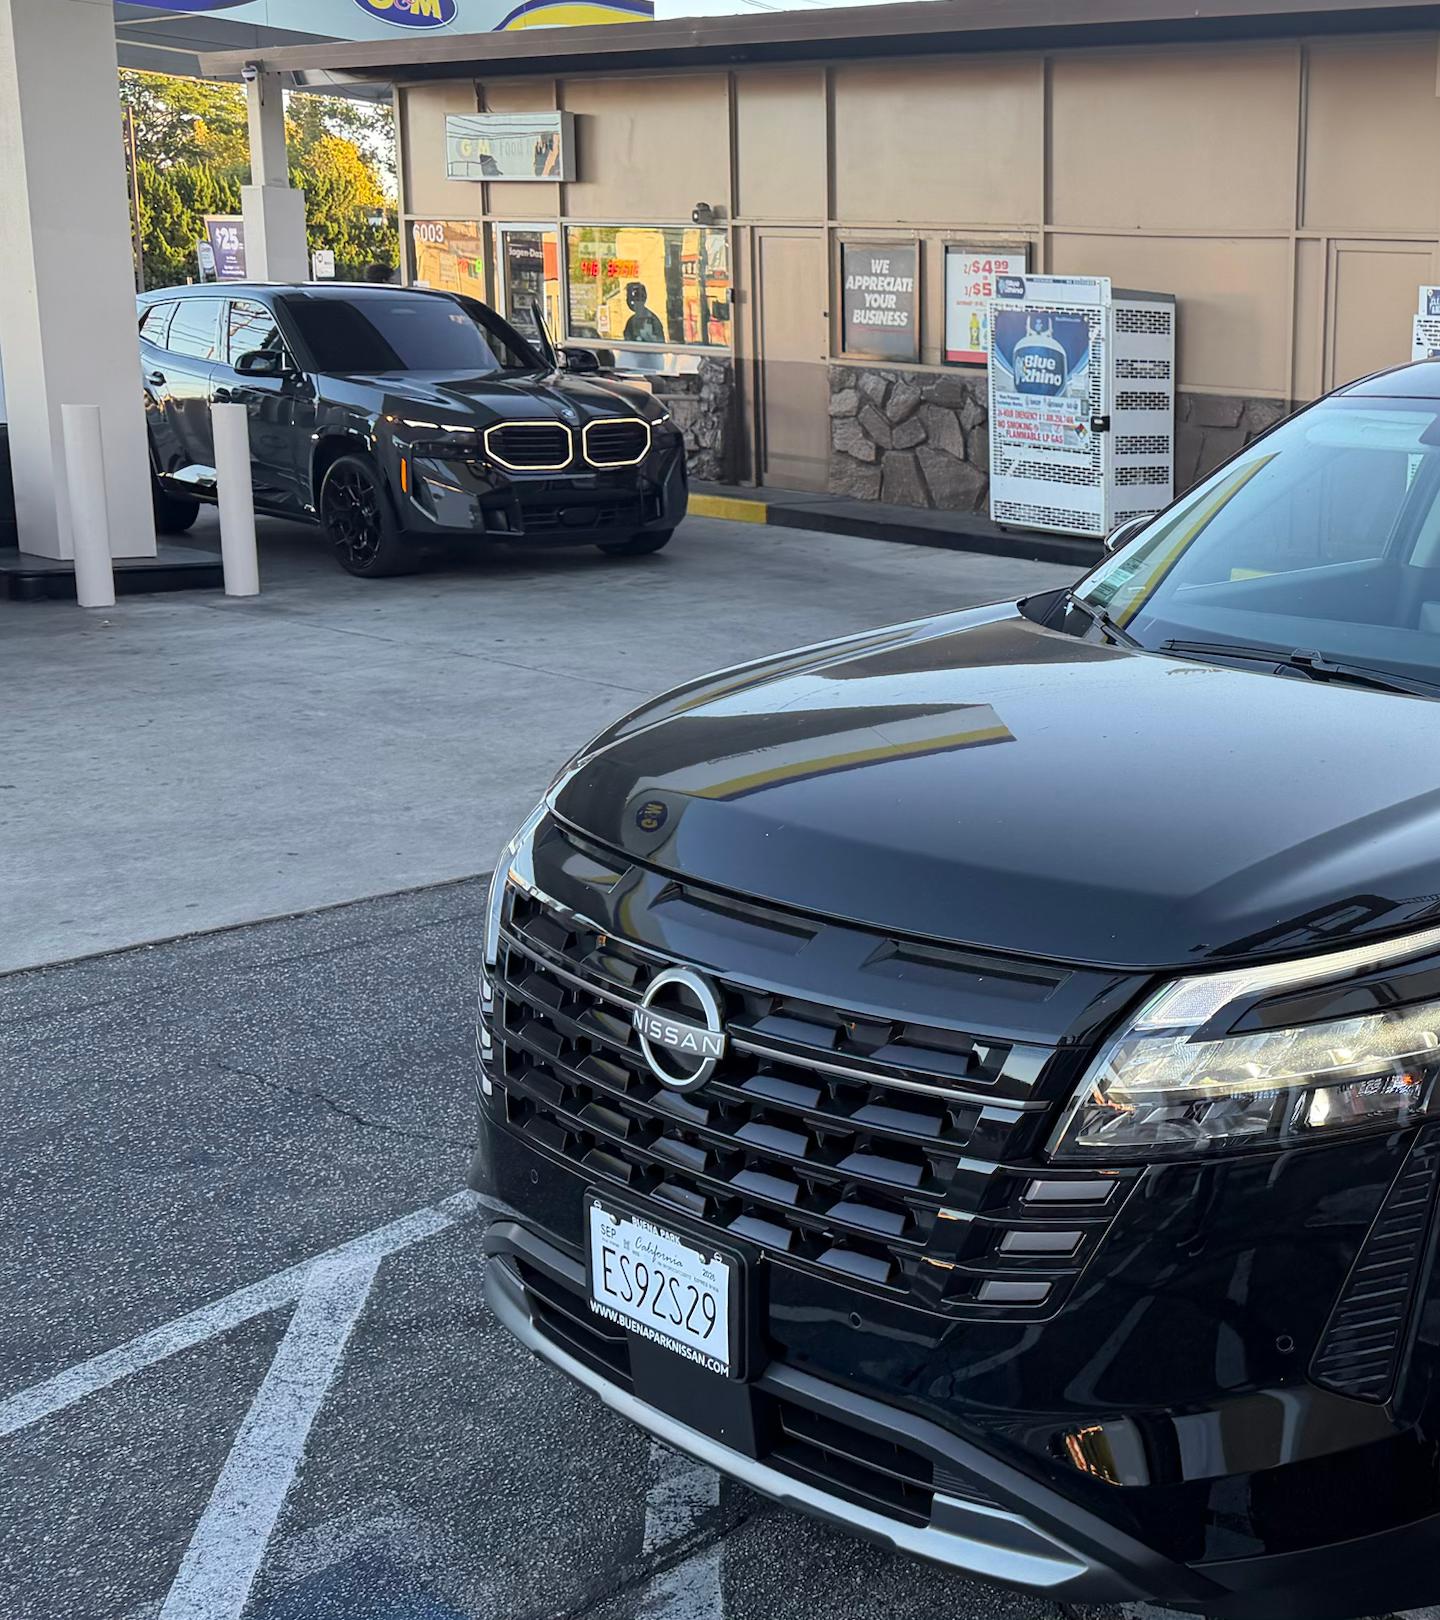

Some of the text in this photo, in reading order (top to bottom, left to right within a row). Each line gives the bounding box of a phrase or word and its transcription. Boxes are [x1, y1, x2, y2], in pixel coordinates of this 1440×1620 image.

[215, 227, 239, 250] $25
[413, 223, 444, 242] 6003
[871, 259, 890, 274] WE
[845, 275, 913, 292] APPRECIATE
[864, 293, 897, 309] YOUR
[852, 309, 908, 326] BUSINESS
[1025, 354, 1056, 371] Blue
[633, 1009, 721, 1055] NISSAN
[601, 1223, 617, 1239] SEP
[631, 1216, 682, 1245] BUENA PARK
[635, 1236, 684, 1267] California
[602, 1245, 717, 1339] ES92S29
[589, 1299, 729, 1378] WWW.BUENAPARKNISSAN.COM
